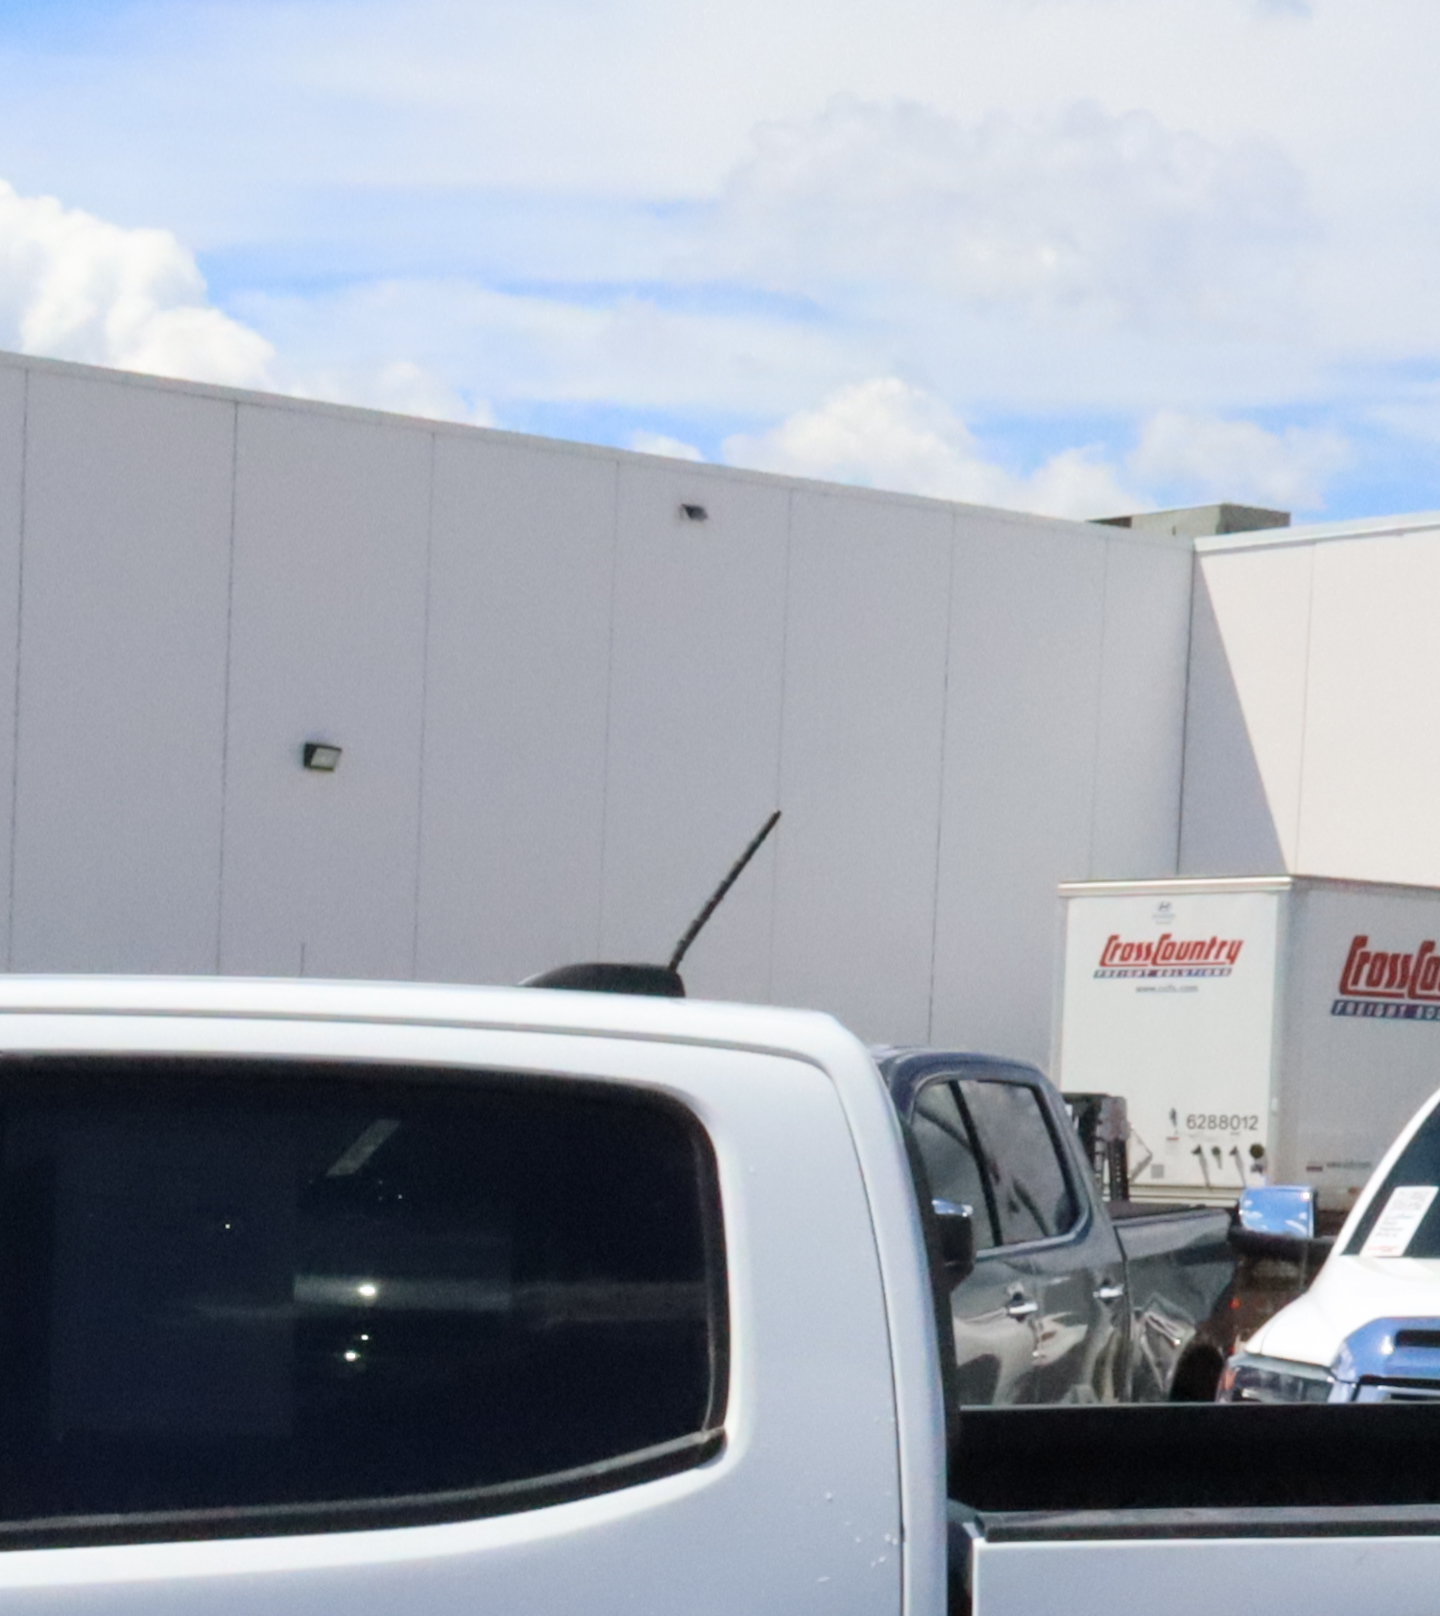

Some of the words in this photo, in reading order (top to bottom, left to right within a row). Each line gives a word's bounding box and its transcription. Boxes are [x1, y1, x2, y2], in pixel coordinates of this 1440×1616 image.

[1099, 934, 1243, 967] CrossCountry
[1332, 1001, 1409, 1019] FREIGHT
[1186, 1114, 1259, 1131] 6288012
